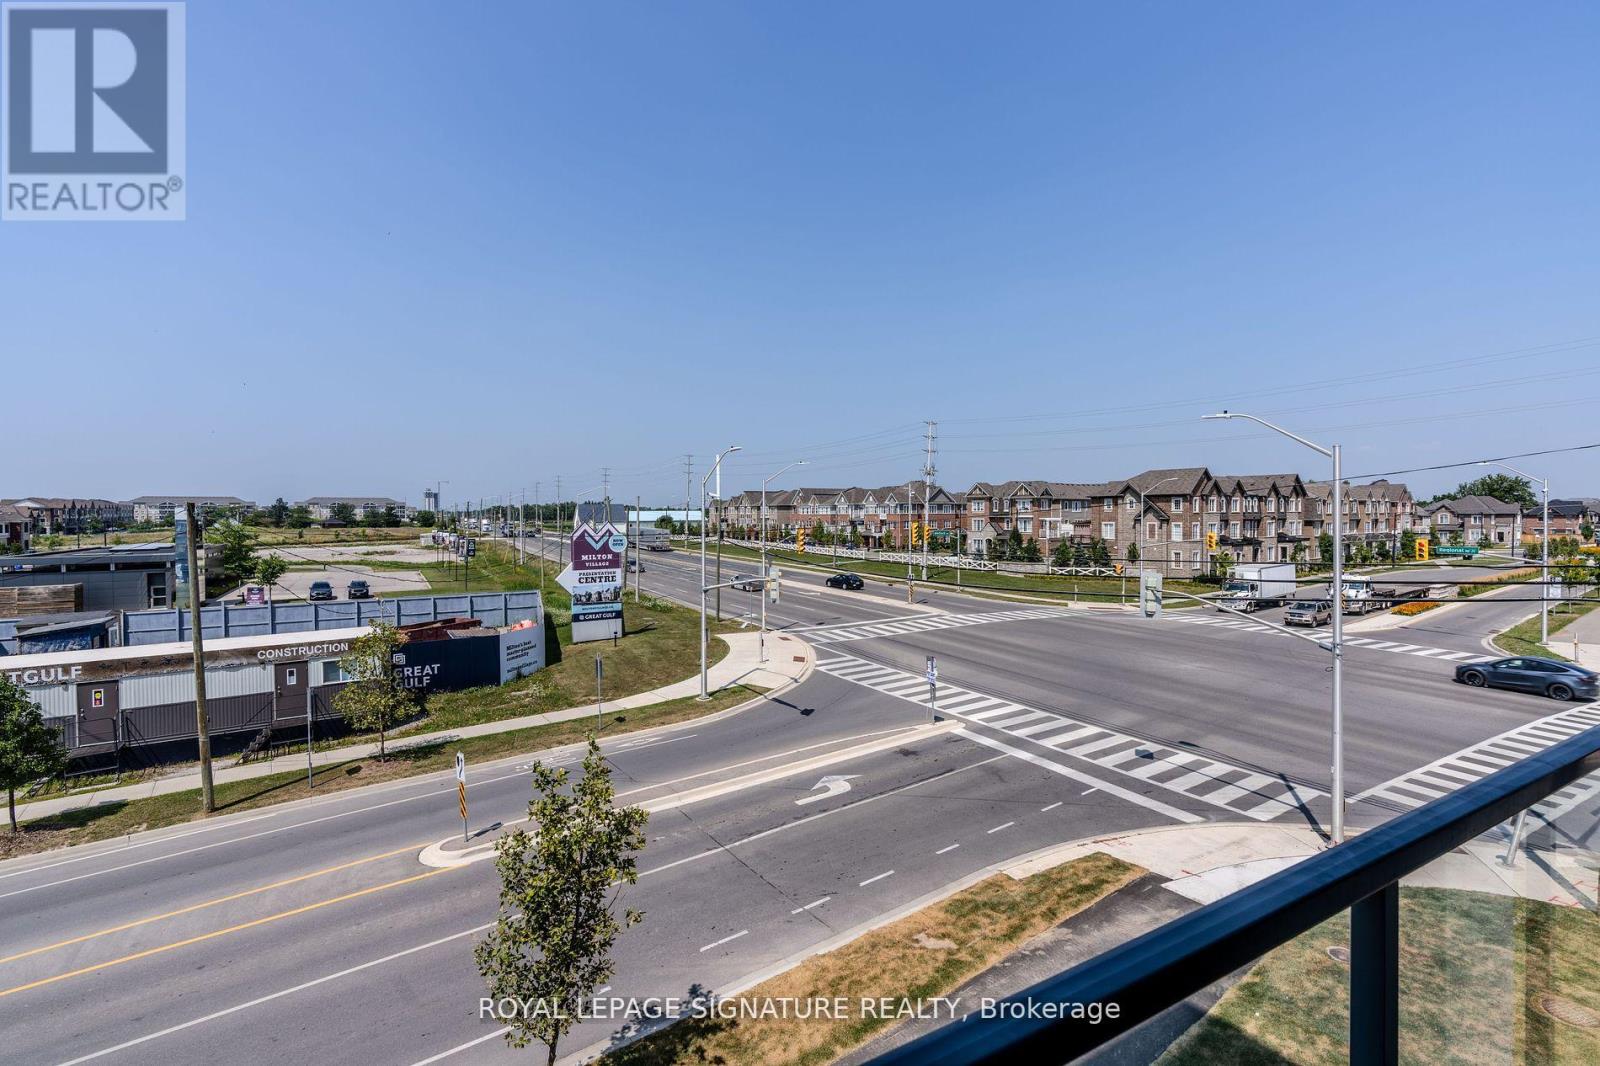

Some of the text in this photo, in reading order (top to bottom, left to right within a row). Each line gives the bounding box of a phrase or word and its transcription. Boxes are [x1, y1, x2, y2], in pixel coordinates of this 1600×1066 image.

[578, 575, 617, 584] CENTRE
[257, 642, 349, 659] CONSTRUCTION
[393, 663, 440, 678] GREAT
[394, 676, 431, 689] GULF
